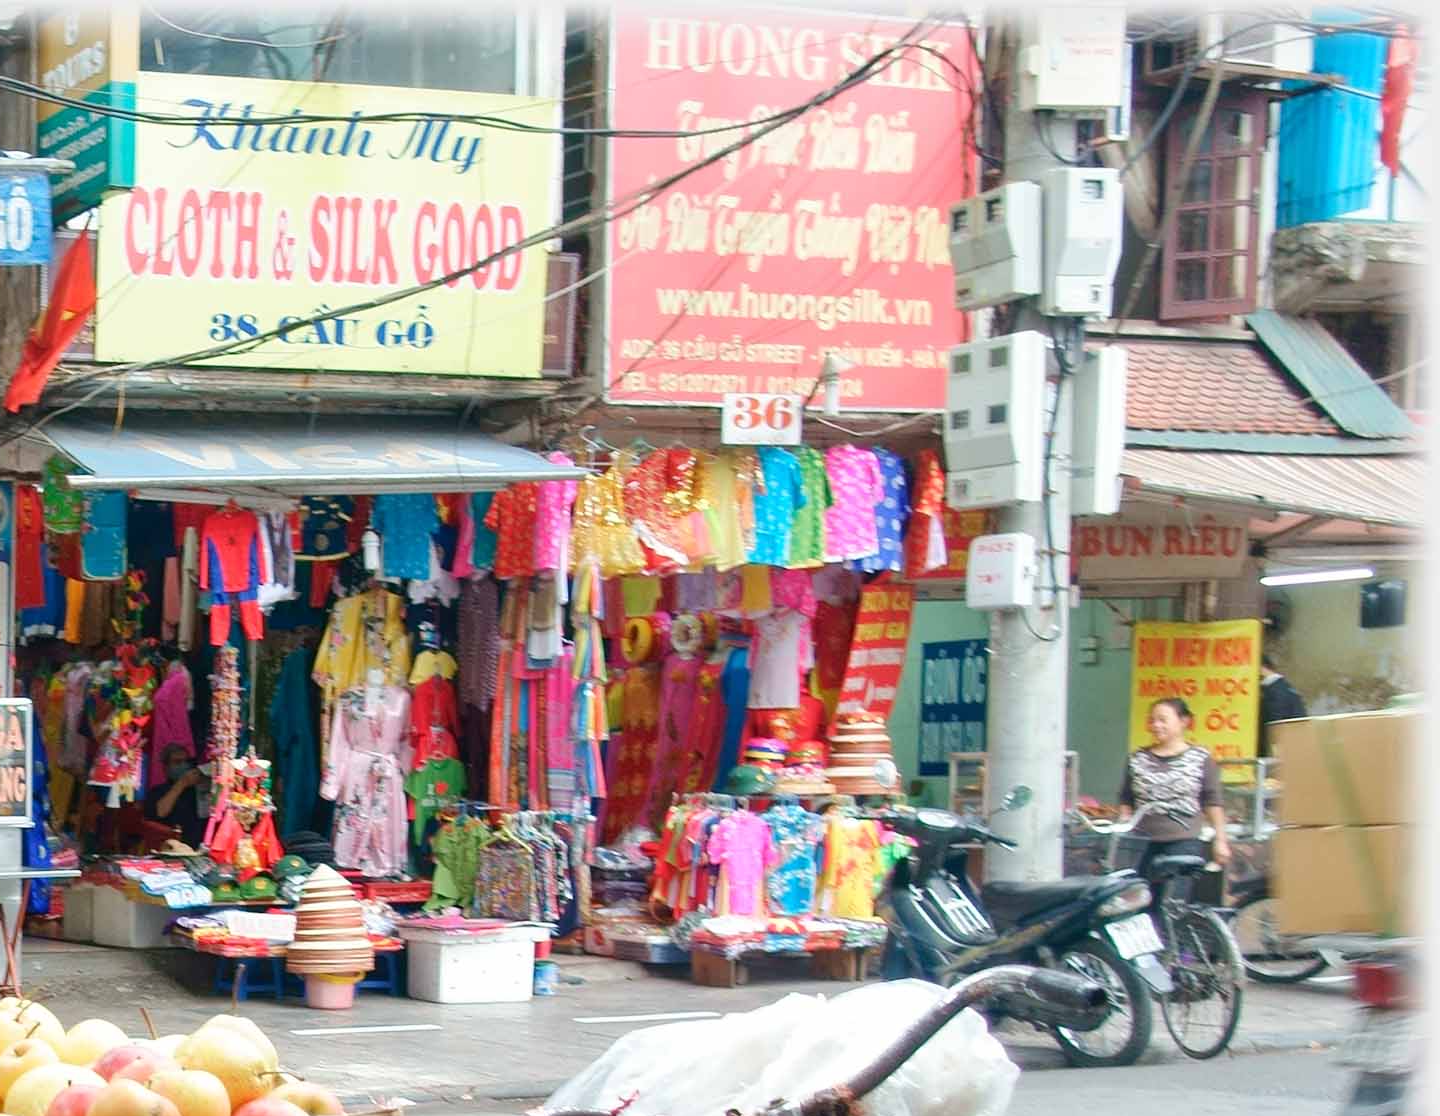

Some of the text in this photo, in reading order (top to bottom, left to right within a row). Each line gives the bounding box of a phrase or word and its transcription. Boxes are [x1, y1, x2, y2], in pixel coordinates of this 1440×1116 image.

[644, 16, 953, 93] HUONG SILK
[165, 97, 380, 158] Khánh
[123, 185, 527, 293] CLOTH & SILK GOOD
[209, 312, 260, 343] 38
[655, 281, 934, 331] www.huongsilk.vn
[744, 343, 807, 364] STREET
[731, 395, 795, 431] 36
[138, 438, 503, 471] VISA
